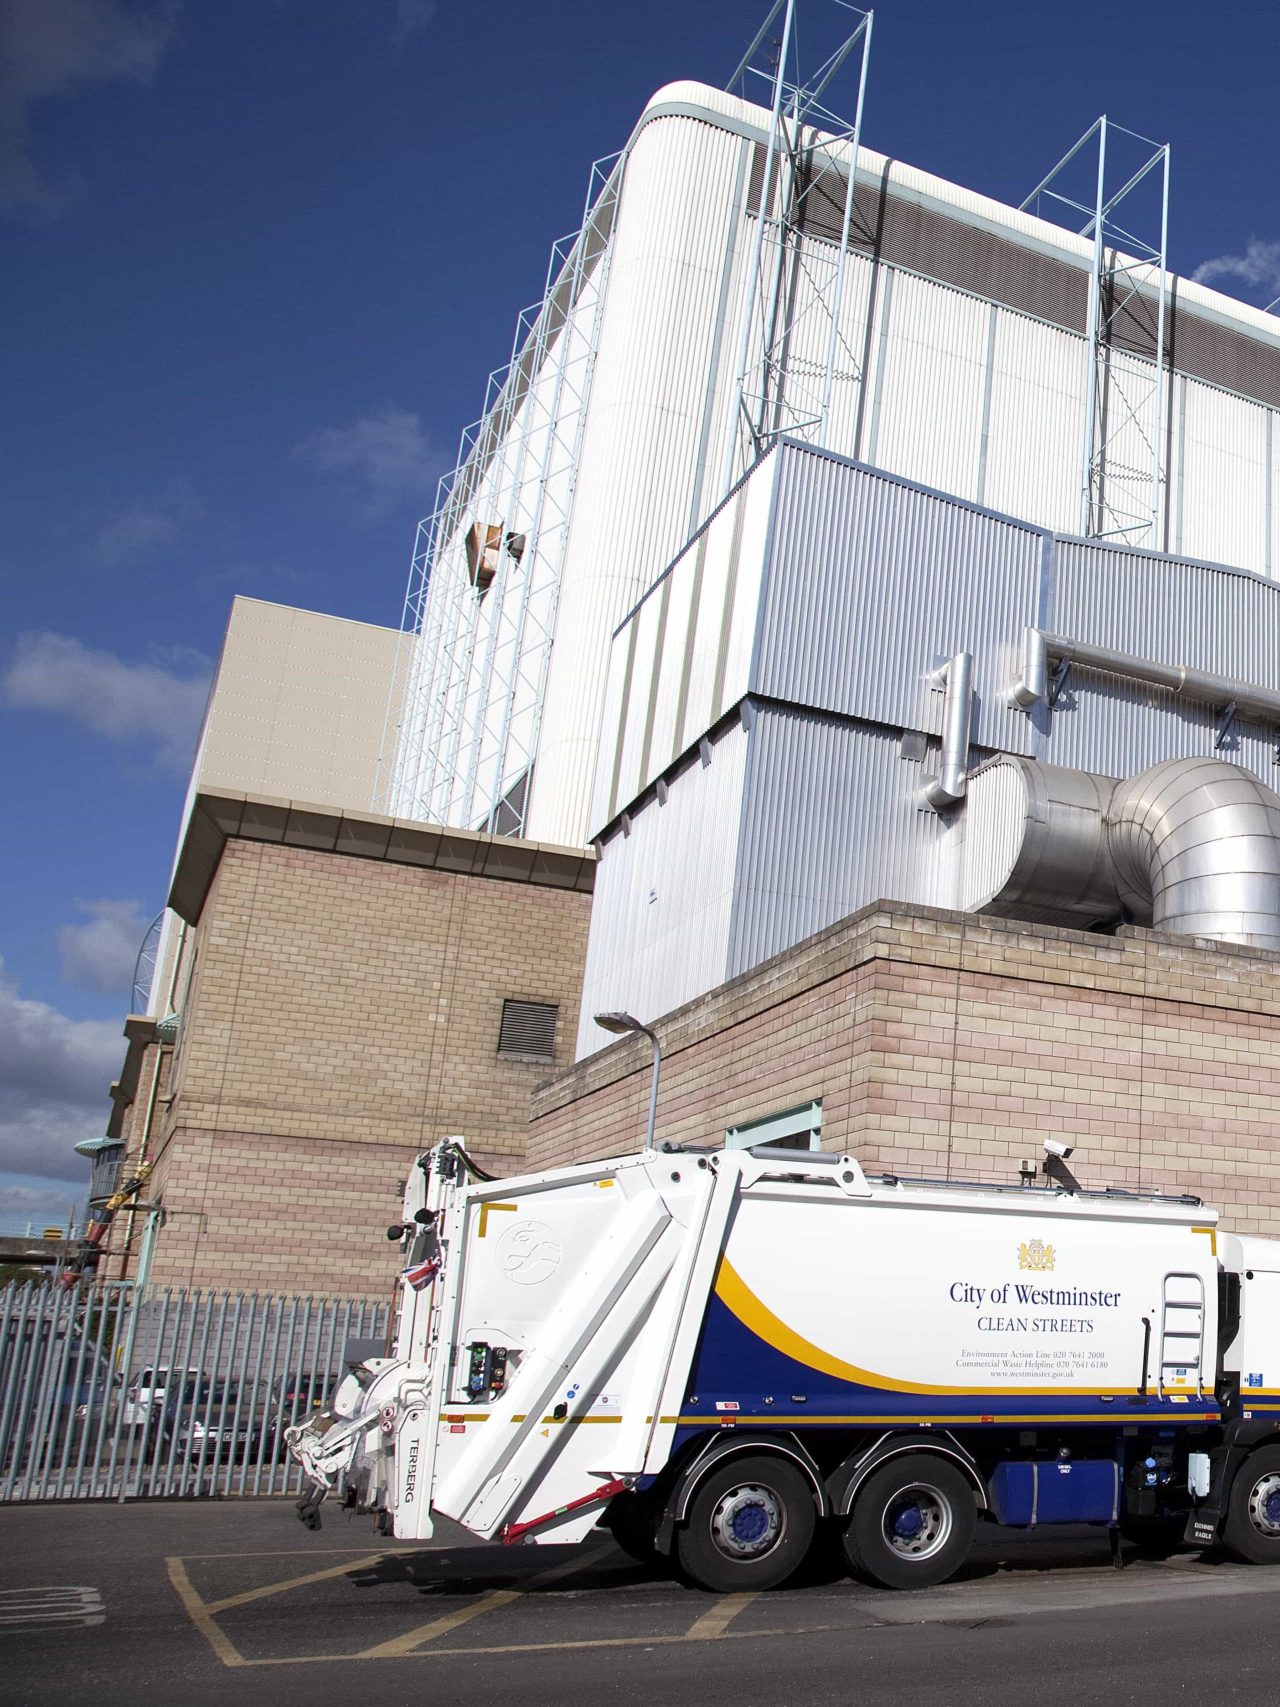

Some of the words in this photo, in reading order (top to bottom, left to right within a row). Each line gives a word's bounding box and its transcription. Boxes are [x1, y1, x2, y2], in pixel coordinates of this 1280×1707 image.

[949, 1282, 986, 1309] City
[990, 1283, 1010, 1304] of
[1014, 1284, 1121, 1307] Westminster
[977, 1316, 1028, 1332] CLEAN
[1032, 1318, 1094, 1333] STREETS
[961, 1349, 1008, 1359] Environment
[1009, 1350, 1034, 1359] Action
[1035, 1350, 1052, 1359] Line
[1053, 1351, 1067, 1359] 020
[1068, 1351, 1086, 1359] 7641
[1087, 1352, 1105, 1360] 2000
[955, 1359, 1000, 1369] Commercial
[1002, 1360, 1023, 1369] Waste
[1024, 1360, 1055, 1370] Helpline
[1071, 1361, 1089, 1370] 7641
[1090, 1361, 1109, 1370] 6180
[990, 1370, 1075, 1380] www.westminster.gov.uk
[405, 1437, 420, 1504] TERBERG
[1195, 1531, 1212, 1540] EAGLE
